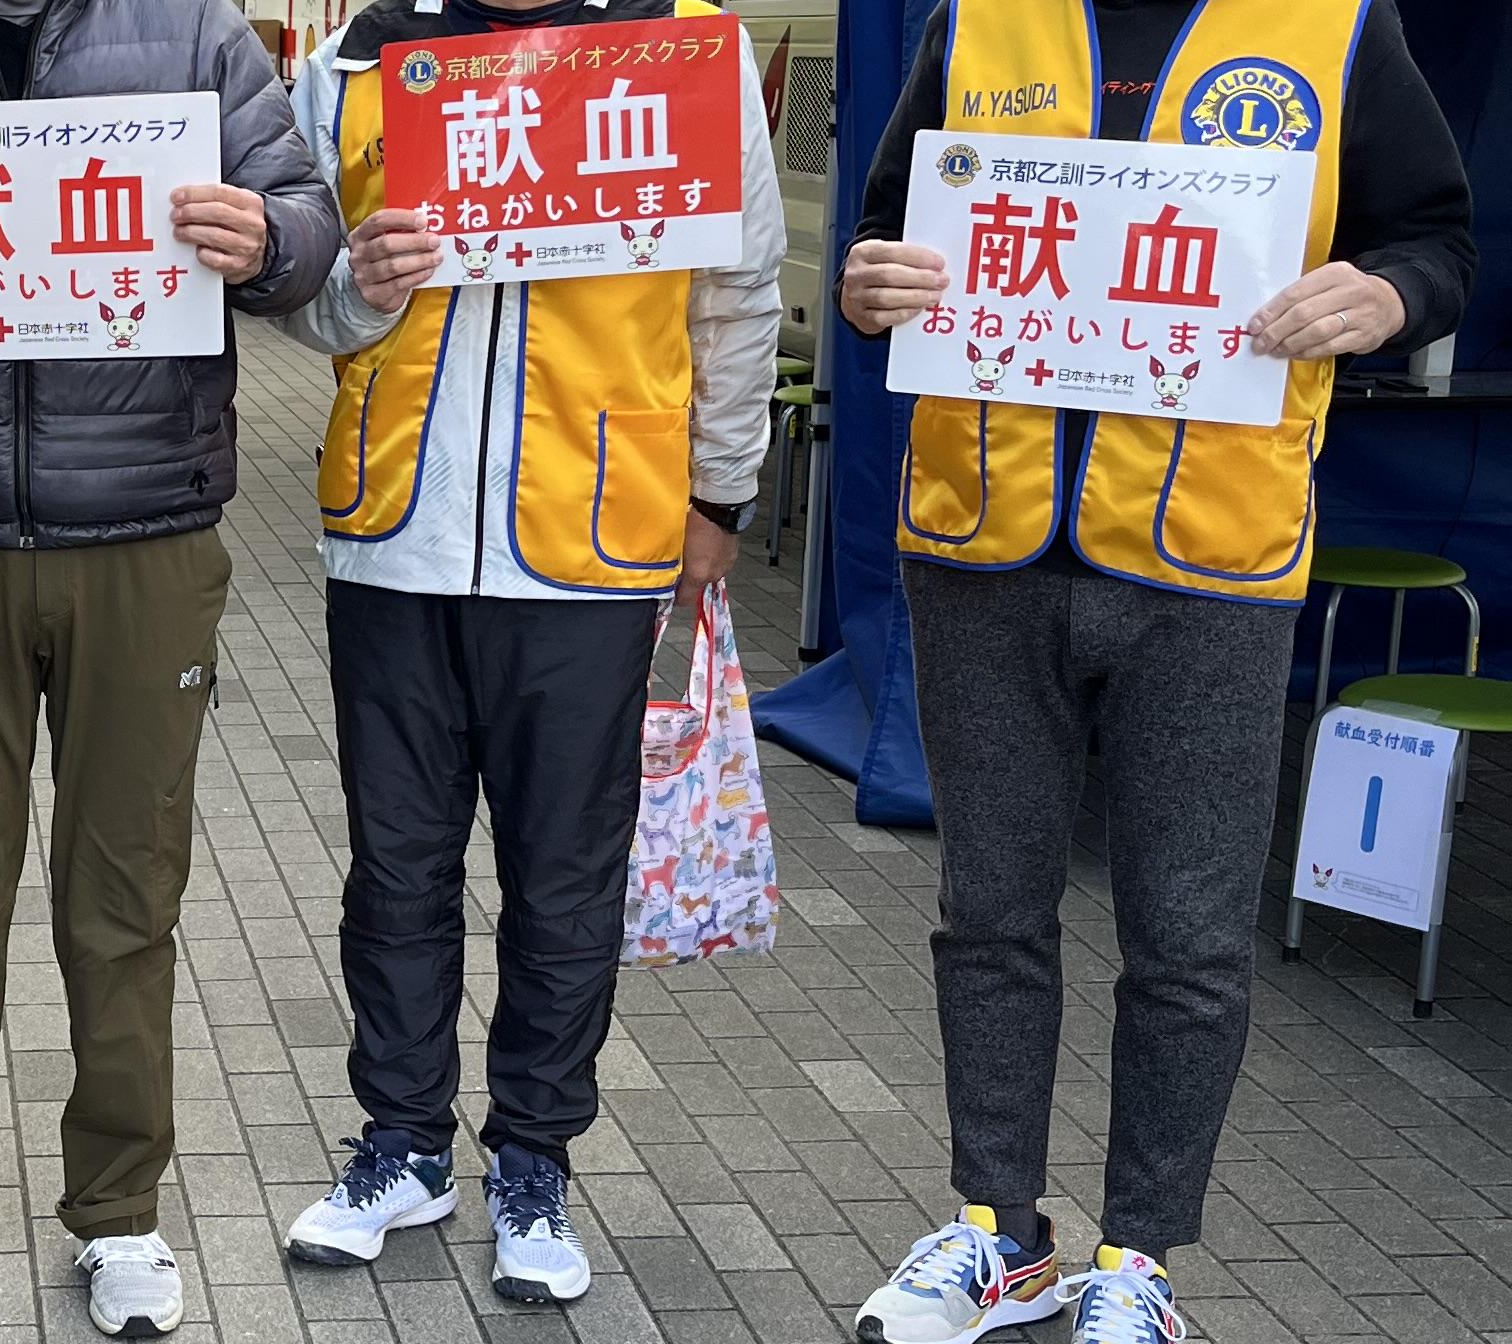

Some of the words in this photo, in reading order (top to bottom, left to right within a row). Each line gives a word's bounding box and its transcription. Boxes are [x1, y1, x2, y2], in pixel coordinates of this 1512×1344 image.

[445, 32, 728, 82] 京都乙訓ライオンズクラブ
[1221, 71, 1290, 96] LIONS
[440, 76, 678, 192] 献血
[1236, 99, 1268, 138] L
[989, 157, 1281, 198] 京都乙訓ライオンズクラブ
[414, 177, 713, 233] おねがいします
[965, 192, 1221, 310] 献血
[922, 303, 1252, 359] おねがいします
[1058, 368, 1135, 388] 日本赤十字社
[1334, 721, 1435, 757] 献血受付順番
[1360, 775, 1383, 853] 1
